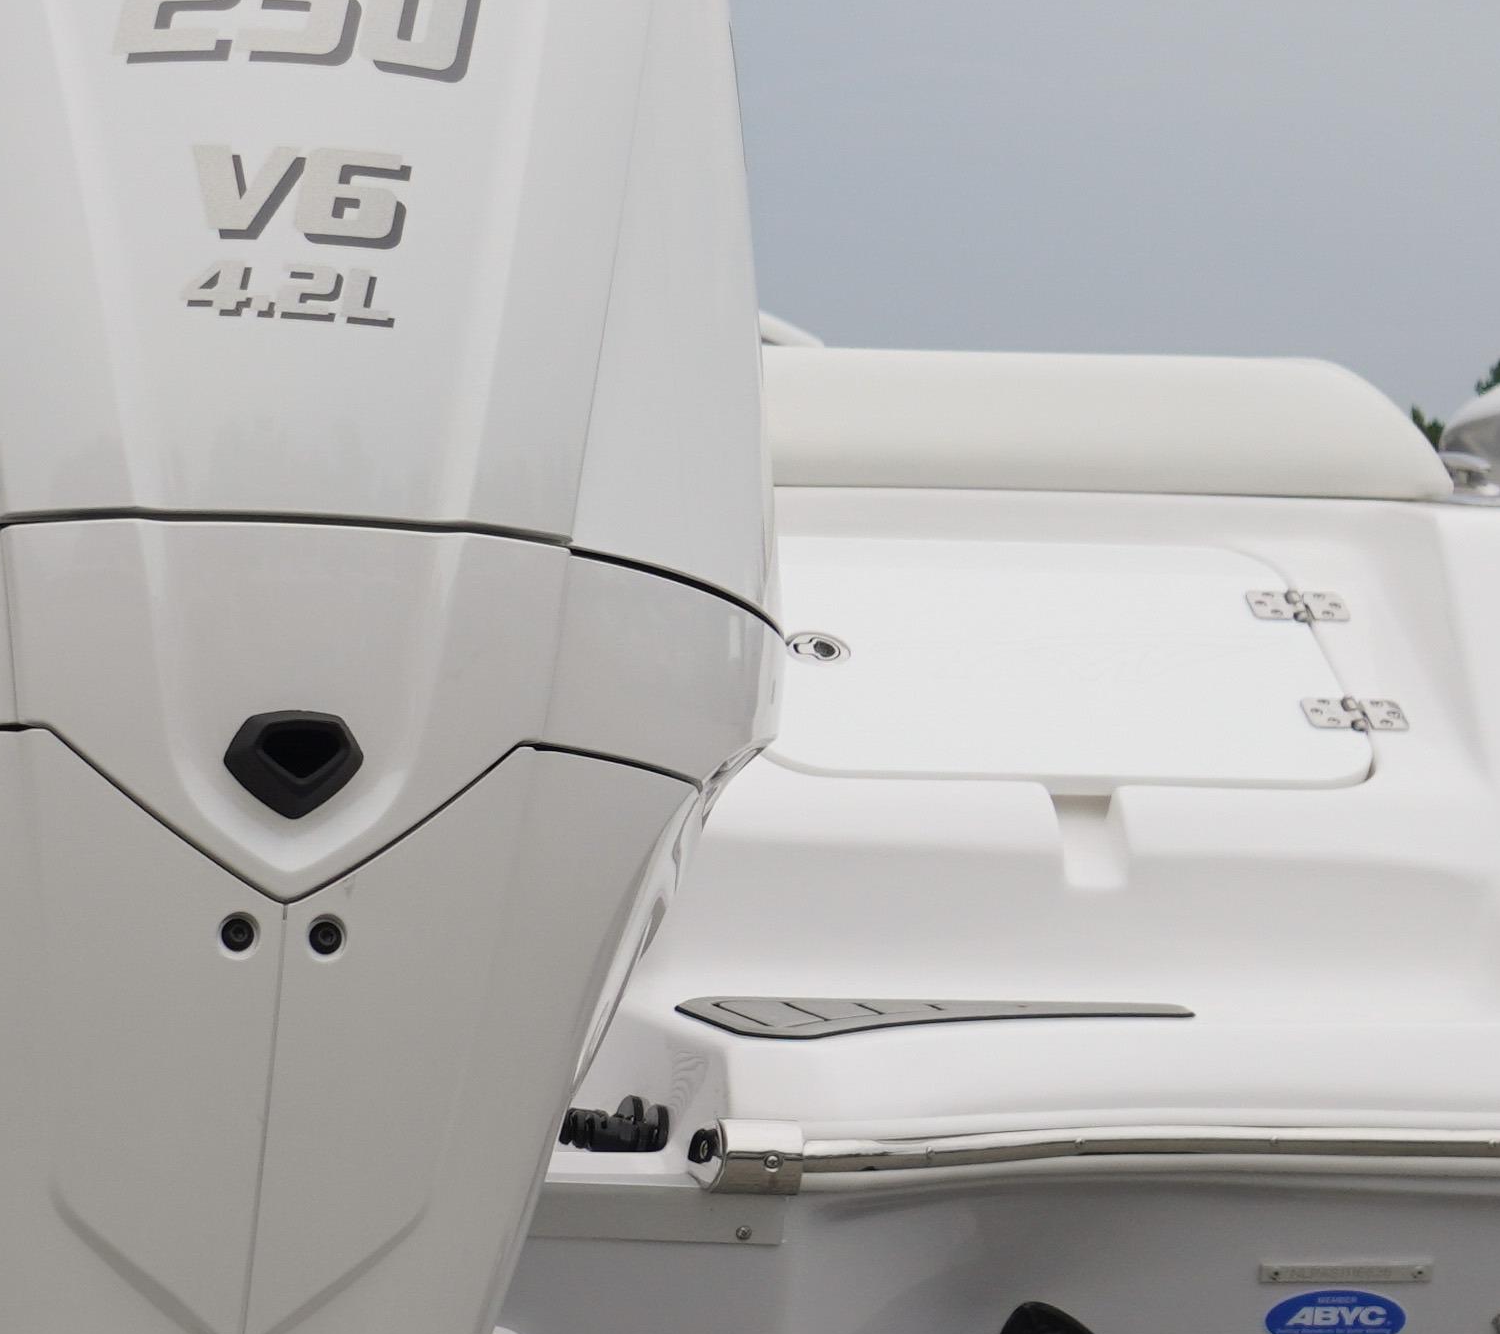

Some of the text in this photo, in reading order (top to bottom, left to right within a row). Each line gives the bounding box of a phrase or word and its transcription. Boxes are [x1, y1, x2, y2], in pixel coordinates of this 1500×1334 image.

[192, 144, 412, 250] V6
[180, 260, 395, 329] 4.2L
[1285, 1305, 1388, 1327] ABYC
